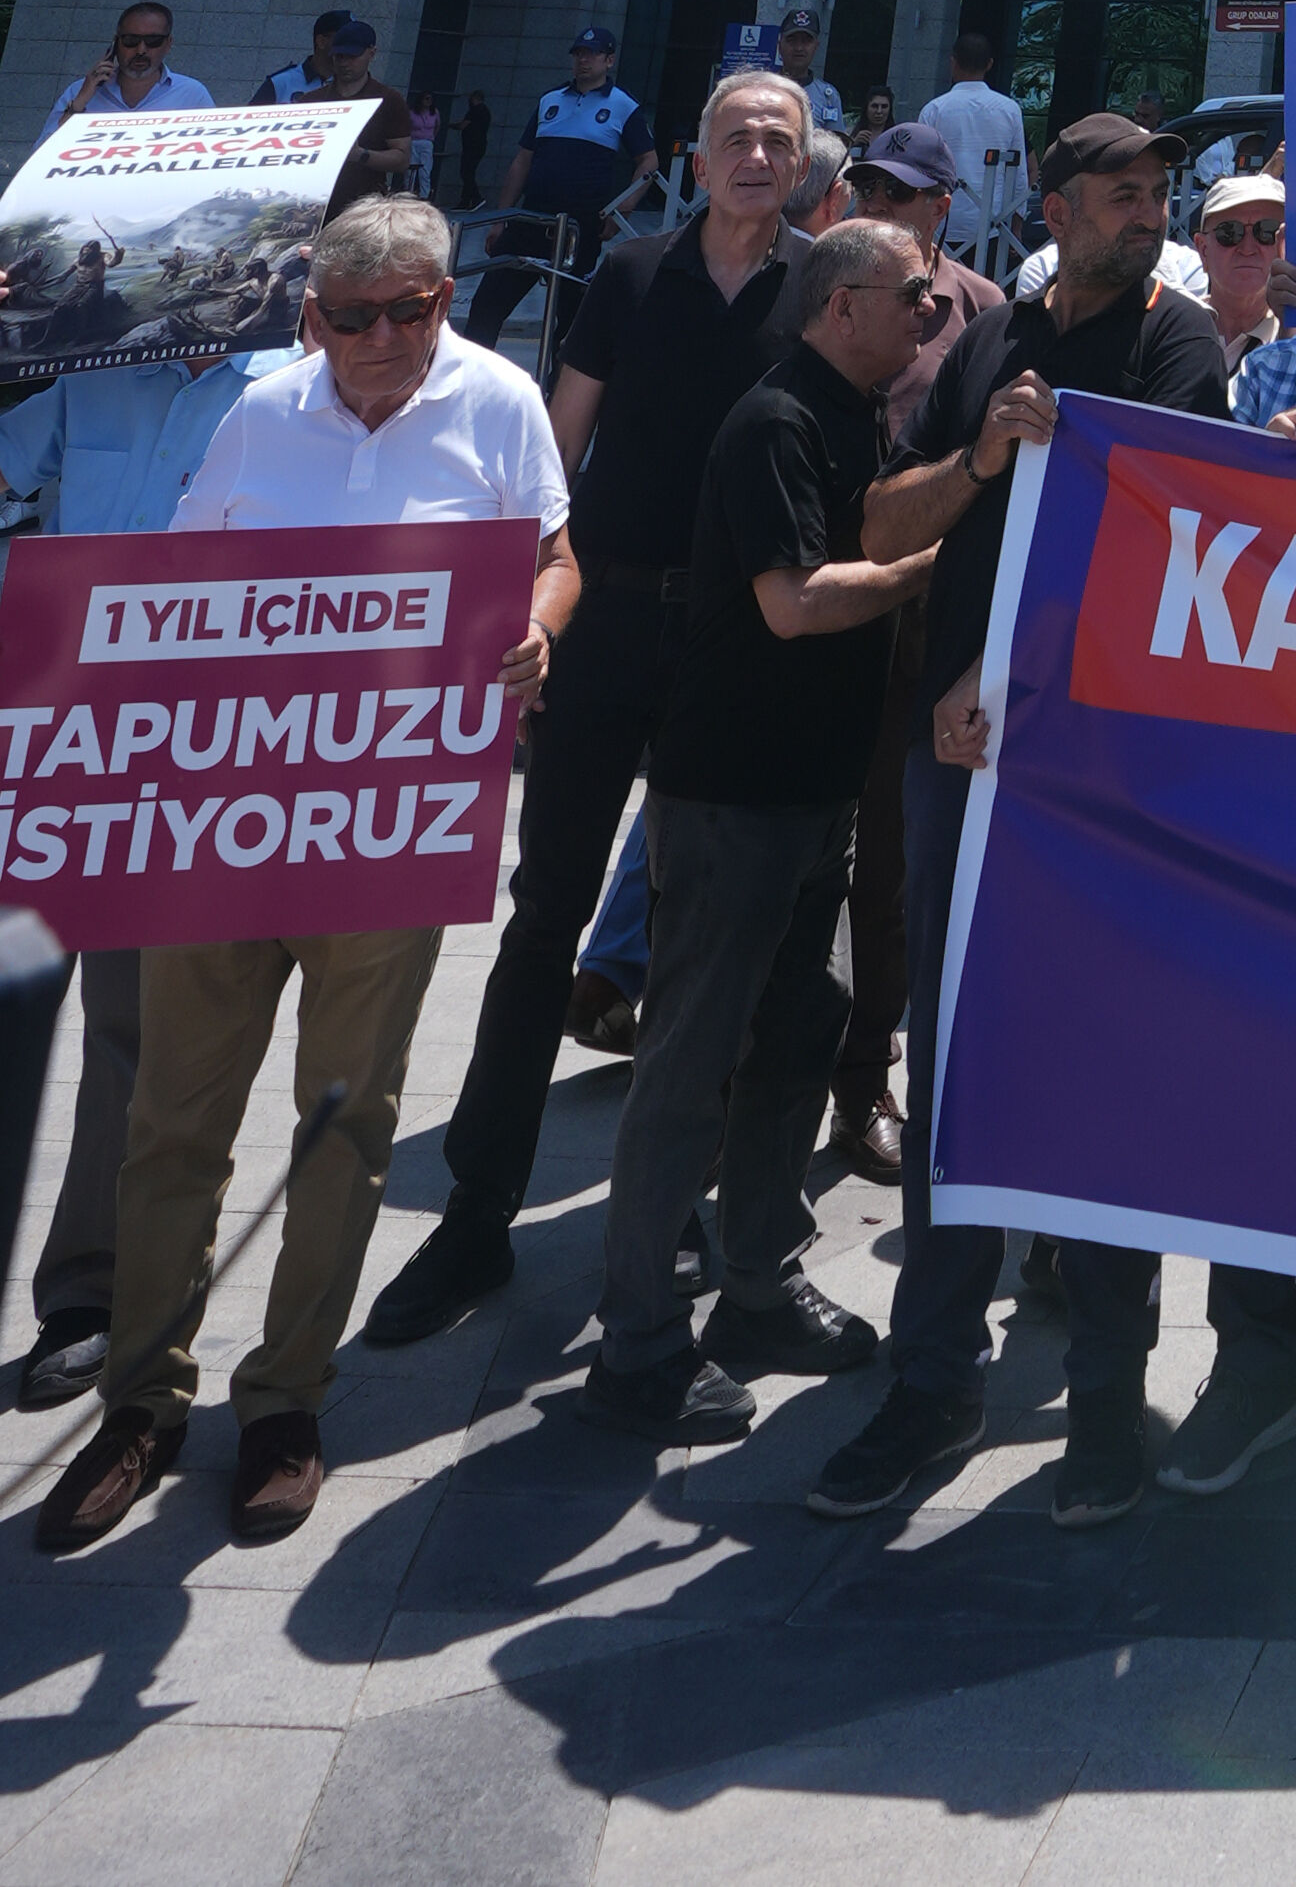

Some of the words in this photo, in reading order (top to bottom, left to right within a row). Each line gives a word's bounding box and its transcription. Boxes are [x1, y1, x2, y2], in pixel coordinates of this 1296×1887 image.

[58, 132, 326, 162] ORTAÇAĞ
[75, 131, 133, 144] 21.
[151, 120, 339, 143] yüzyılda
[45, 150, 320, 180] MAHALLELERİ
[18, 361, 65, 377] GÜNEY
[74, 352, 132, 369] ANKARA
[142, 342, 229, 361] PLATFORMU
[105, 601, 126, 645] 1
[141, 597, 223, 643] YIL
[238, 582, 430, 647] İÇİNDE
[0, 682, 505, 780] TAPUMUZU
